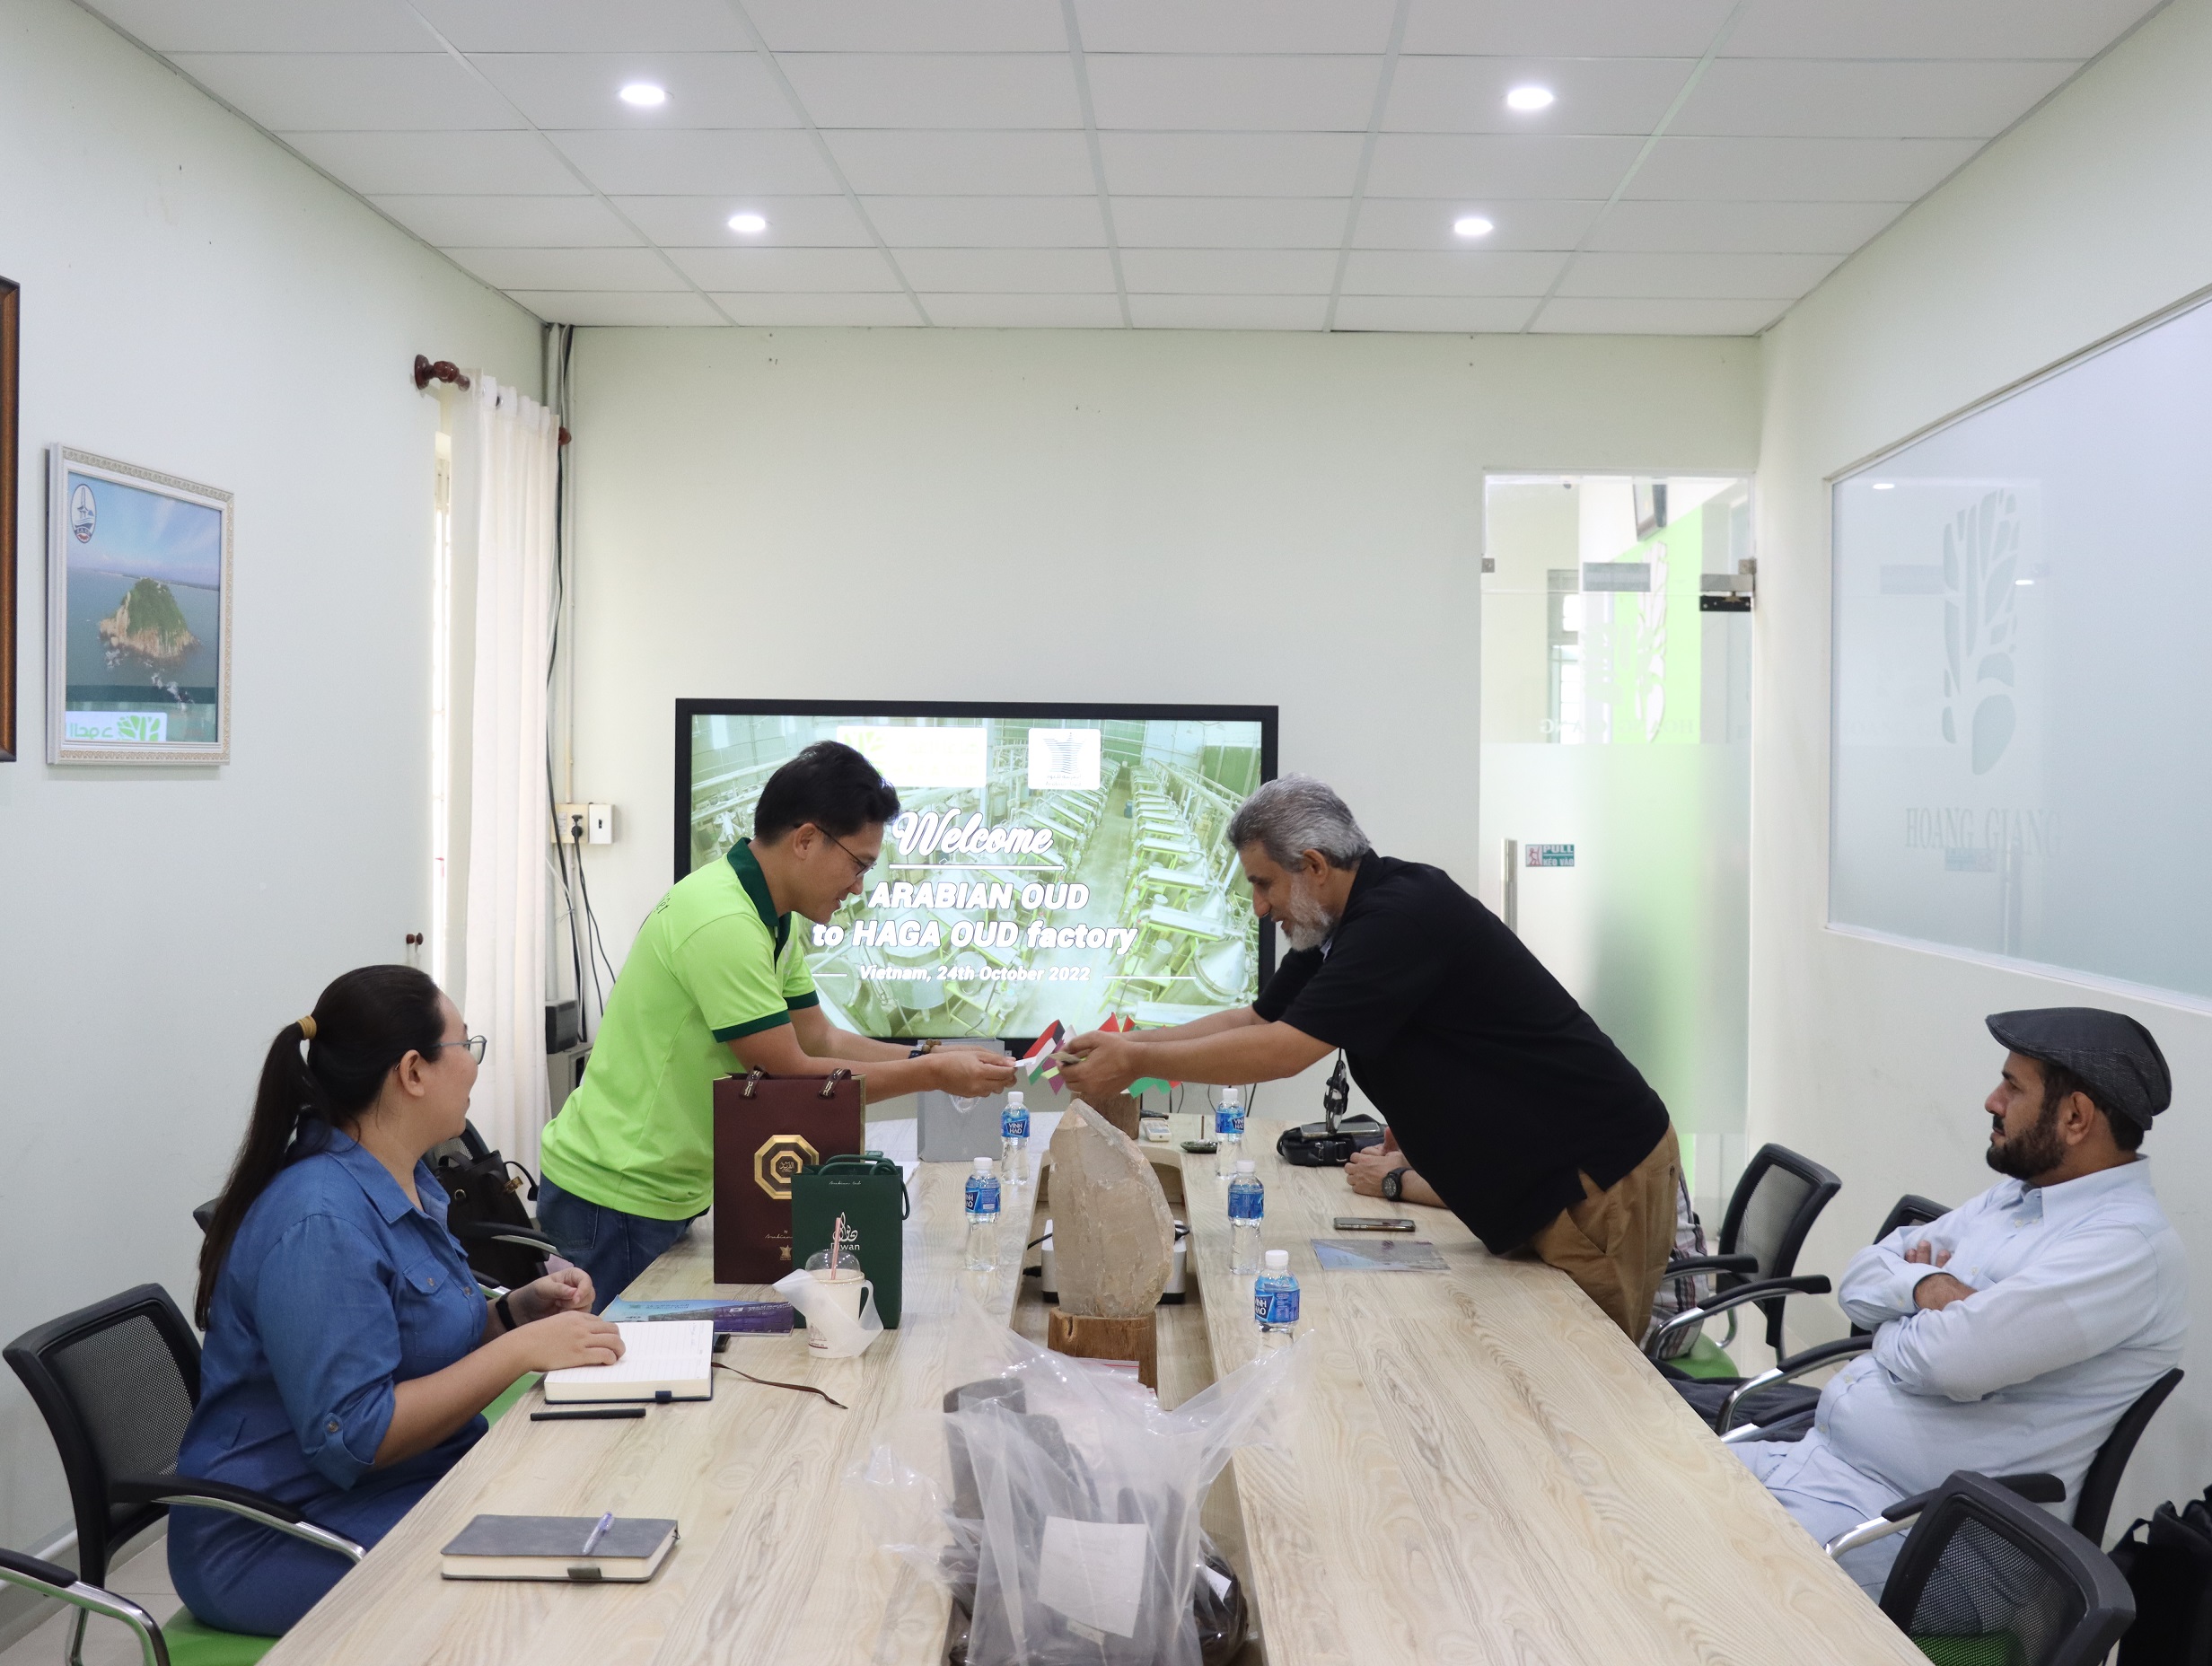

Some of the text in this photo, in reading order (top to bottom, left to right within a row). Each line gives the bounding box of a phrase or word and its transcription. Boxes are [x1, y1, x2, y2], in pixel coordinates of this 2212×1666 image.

[891, 807, 1054, 856] Welcome
[1543, 845, 1574, 854] PULL
[868, 881, 1090, 910] ARABIAN OUD
[812, 920, 1139, 955] to HAGA OUD factory
[860, 965, 1092, 983] Vietnam, 24th October 2022
